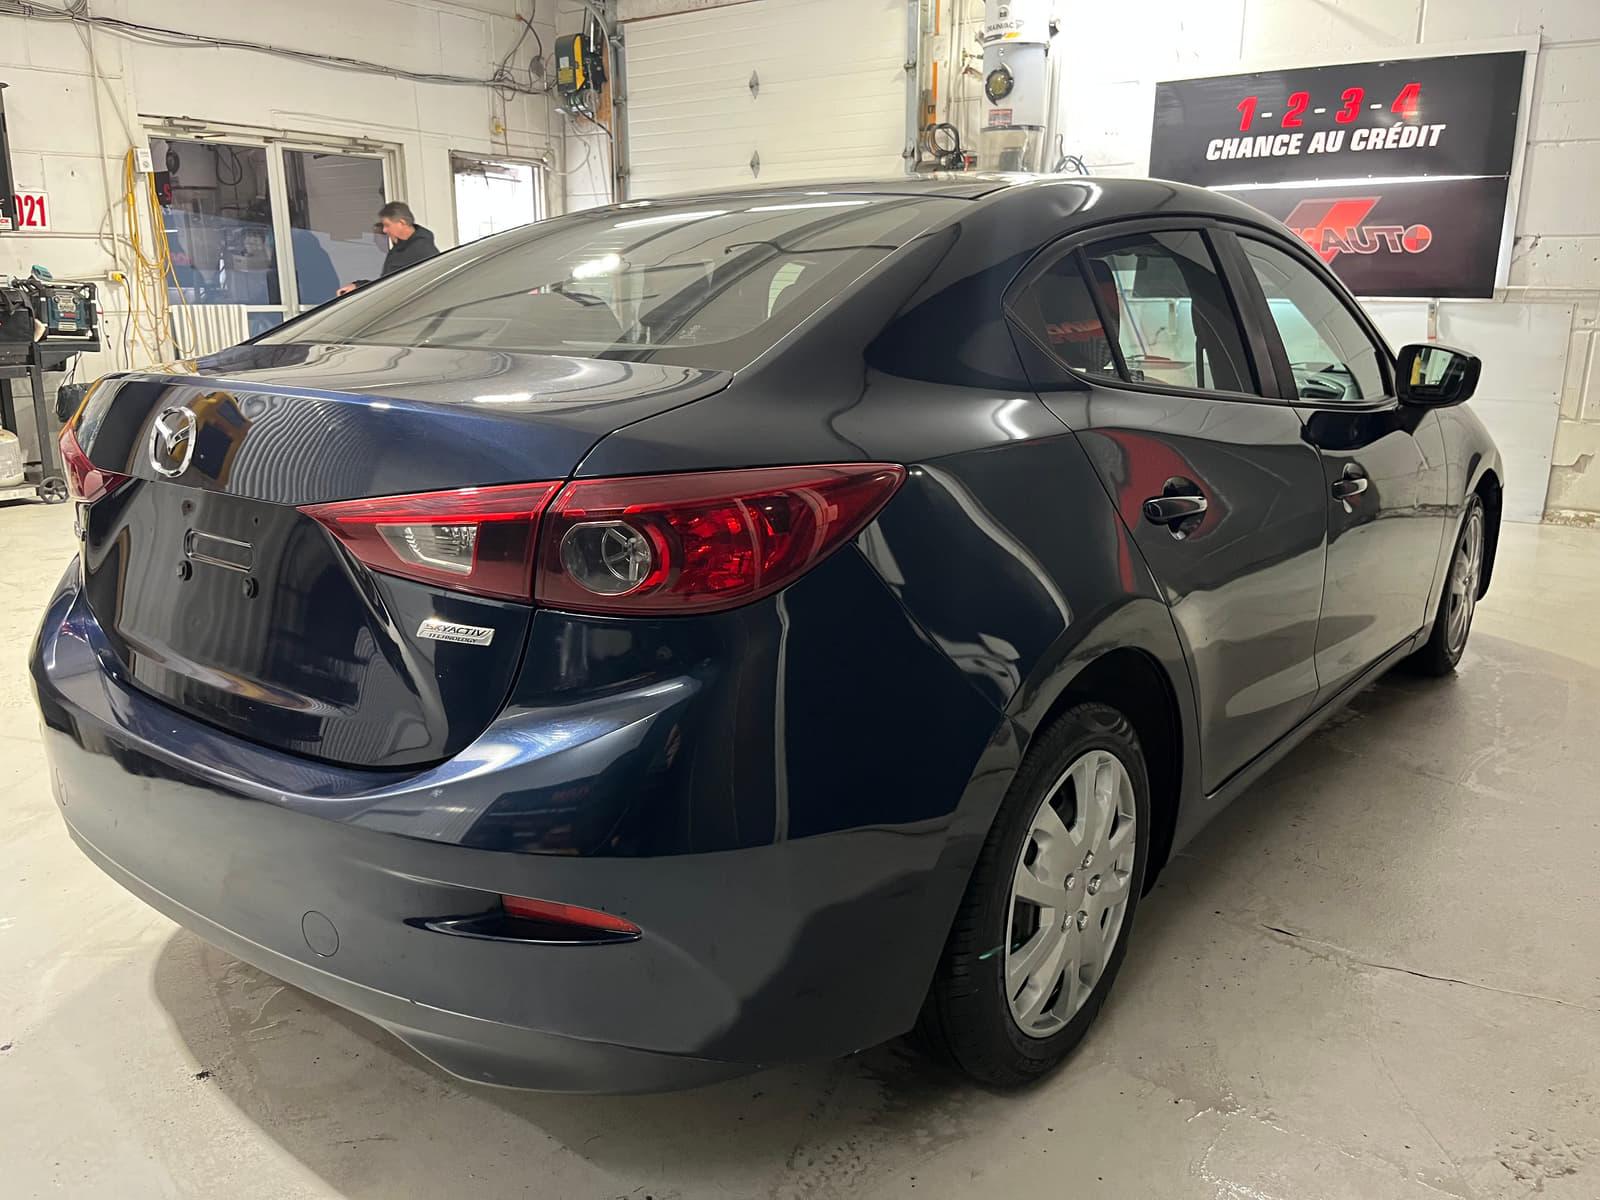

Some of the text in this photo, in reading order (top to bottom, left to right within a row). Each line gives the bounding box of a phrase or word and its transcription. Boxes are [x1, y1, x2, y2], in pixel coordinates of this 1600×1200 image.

[1205, 121, 1446, 161] CHANCE AU CRÉDIT
[423, 623, 491, 637] SKYACTIV
